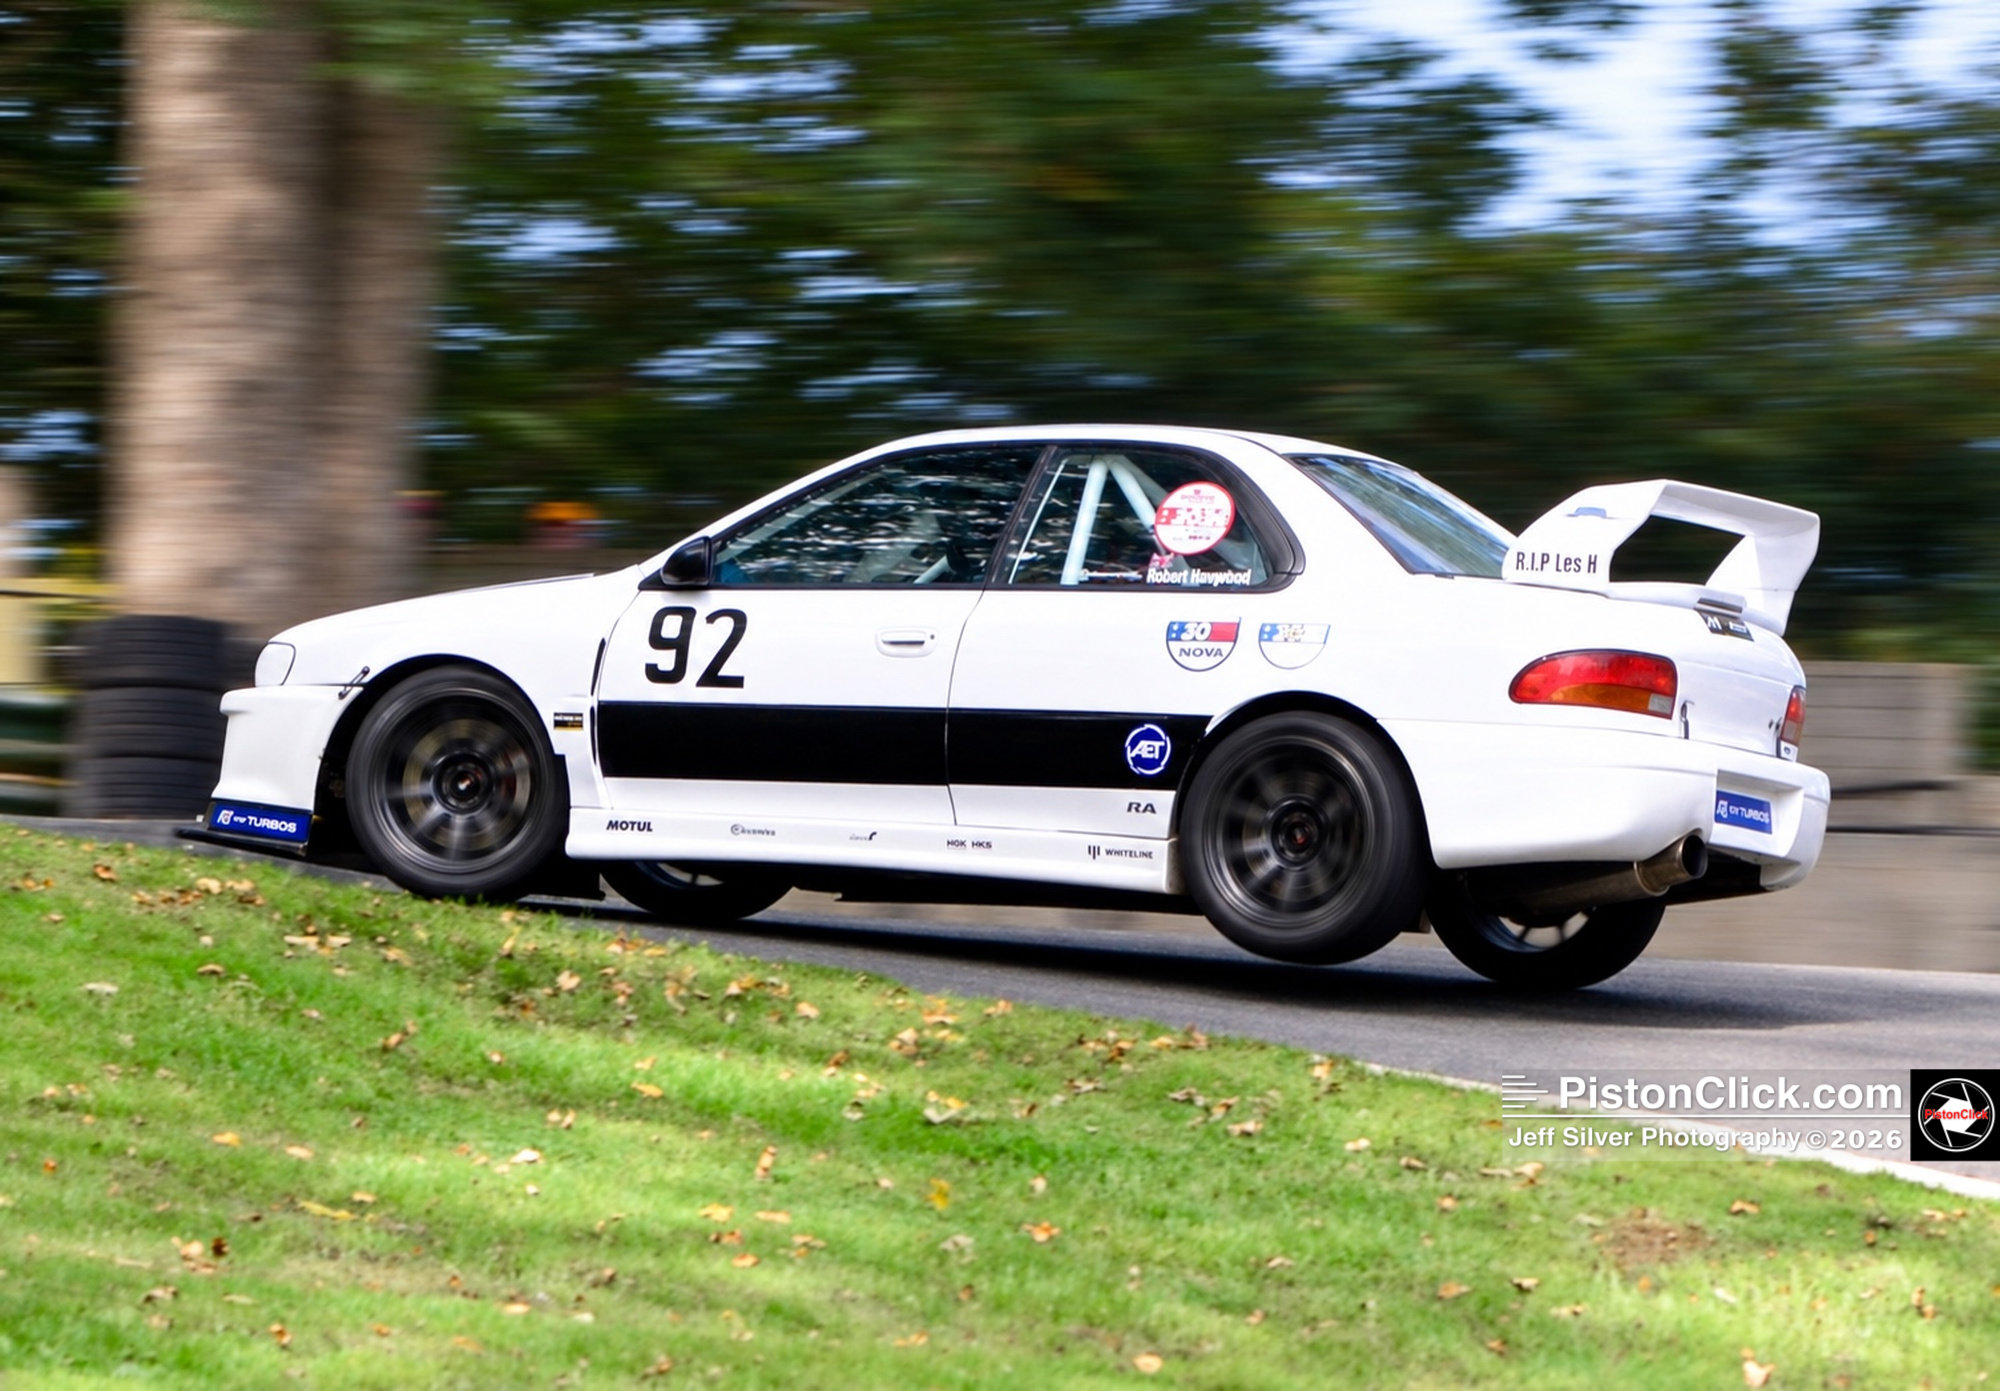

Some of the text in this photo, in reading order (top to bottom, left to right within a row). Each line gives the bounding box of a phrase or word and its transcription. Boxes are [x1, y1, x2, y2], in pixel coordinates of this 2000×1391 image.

[1516, 551, 1597, 574] R.I.P Les H
[1146, 567, 1189, 584] Robert
[1180, 621, 1212, 642] 30
[644, 605, 748, 689] 92
[1179, 647, 1224, 658] NOVA
[1126, 801, 1157, 814] RA
[247, 815, 297, 833] TURBOS
[606, 819, 653, 832] MOTUL
[1104, 848, 1154, 860] WHITELINE
